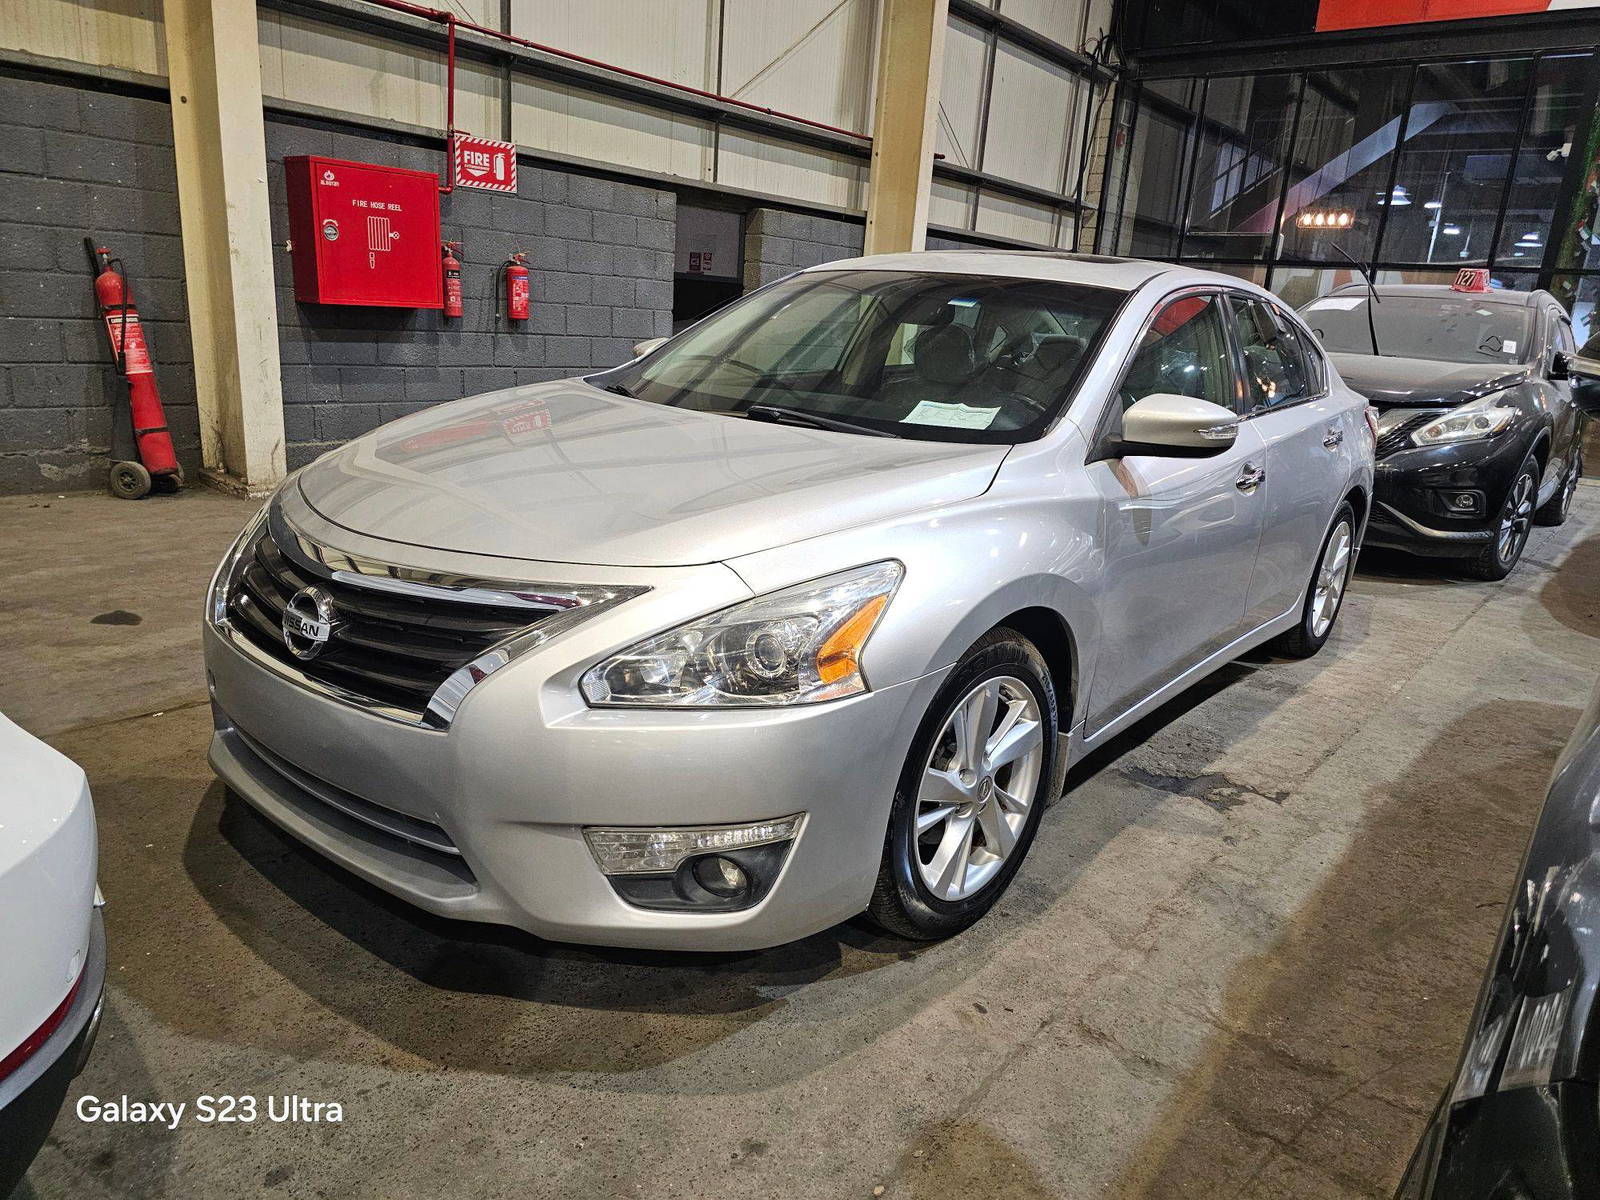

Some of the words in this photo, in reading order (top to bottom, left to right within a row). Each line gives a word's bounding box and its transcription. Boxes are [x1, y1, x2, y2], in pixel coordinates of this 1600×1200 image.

[463, 150, 490, 167] FIRE
[352, 199, 368, 208] FIRE
[370, 201, 386, 210] HOSE
[387, 203, 403, 212] REEL
[1457, 270, 1476, 286] 127
